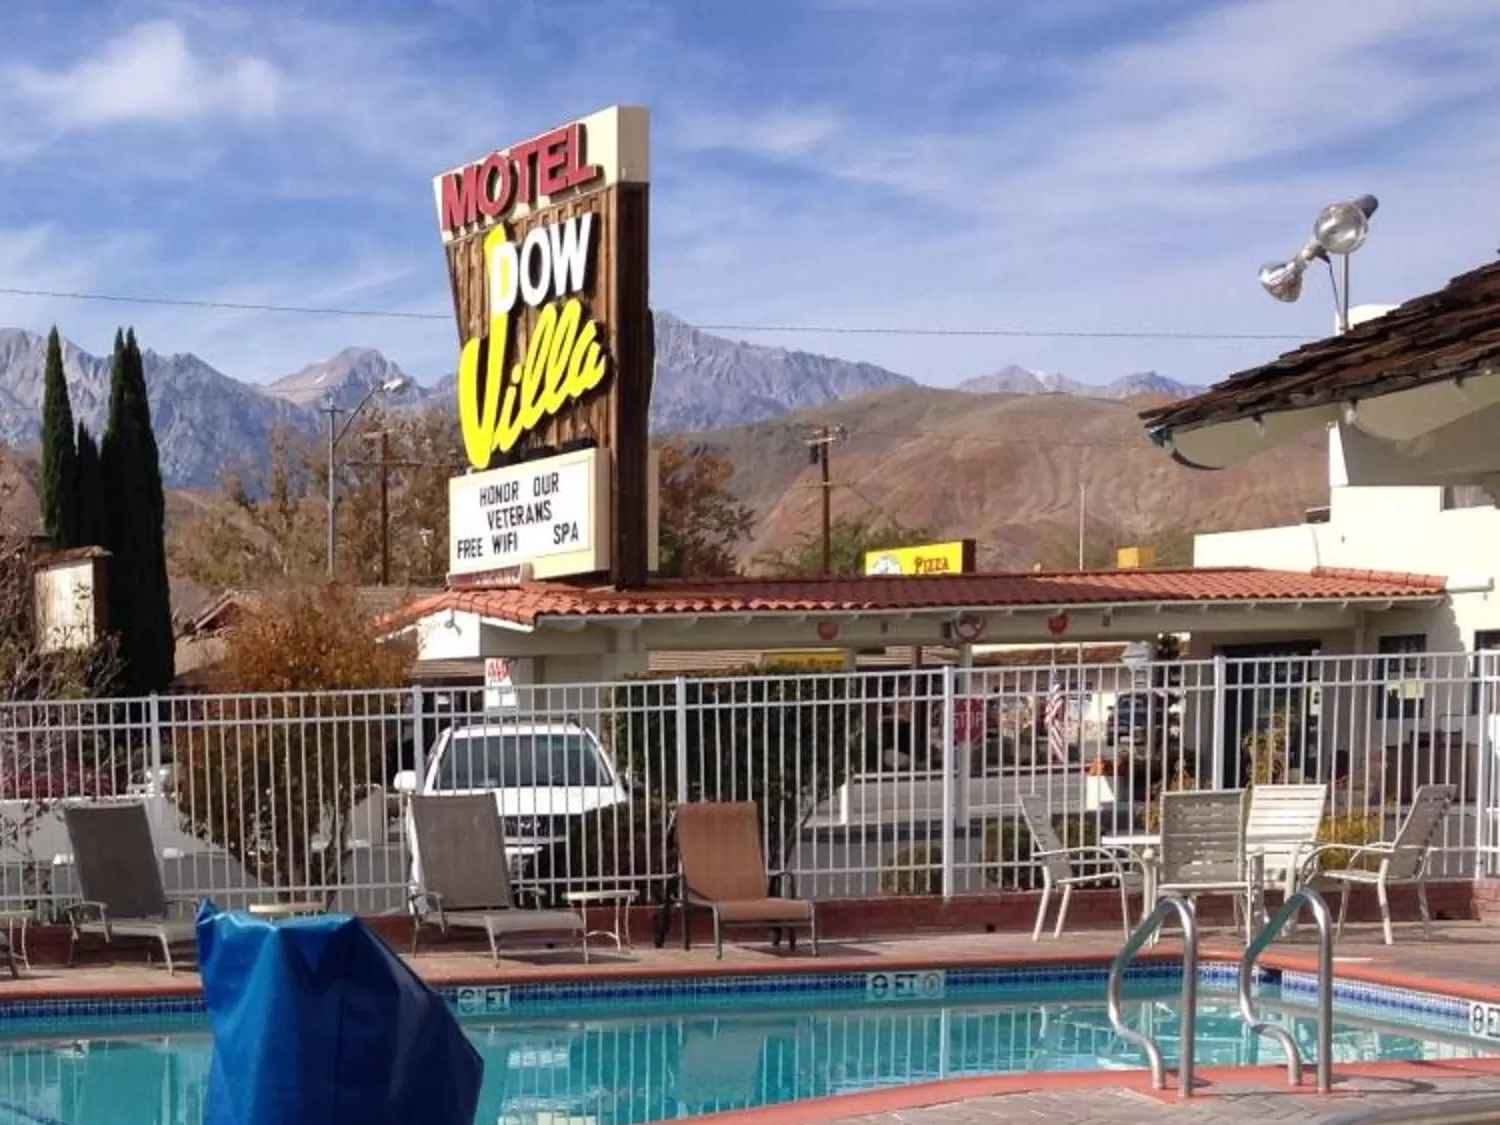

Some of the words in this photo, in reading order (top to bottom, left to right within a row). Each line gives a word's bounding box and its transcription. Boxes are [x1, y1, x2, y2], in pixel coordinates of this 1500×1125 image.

[441, 123, 598, 231] MOTEL
[489, 212, 593, 316] DOW
[459, 298, 607, 469] Villa
[479, 479, 519, 507] HONOR
[533, 472, 559, 497] OUR
[487, 500, 552, 531] VETERANS
[457, 537, 483, 559] FREE
[492, 531, 518, 554] WIFI
[553, 521, 579, 545] SPA
